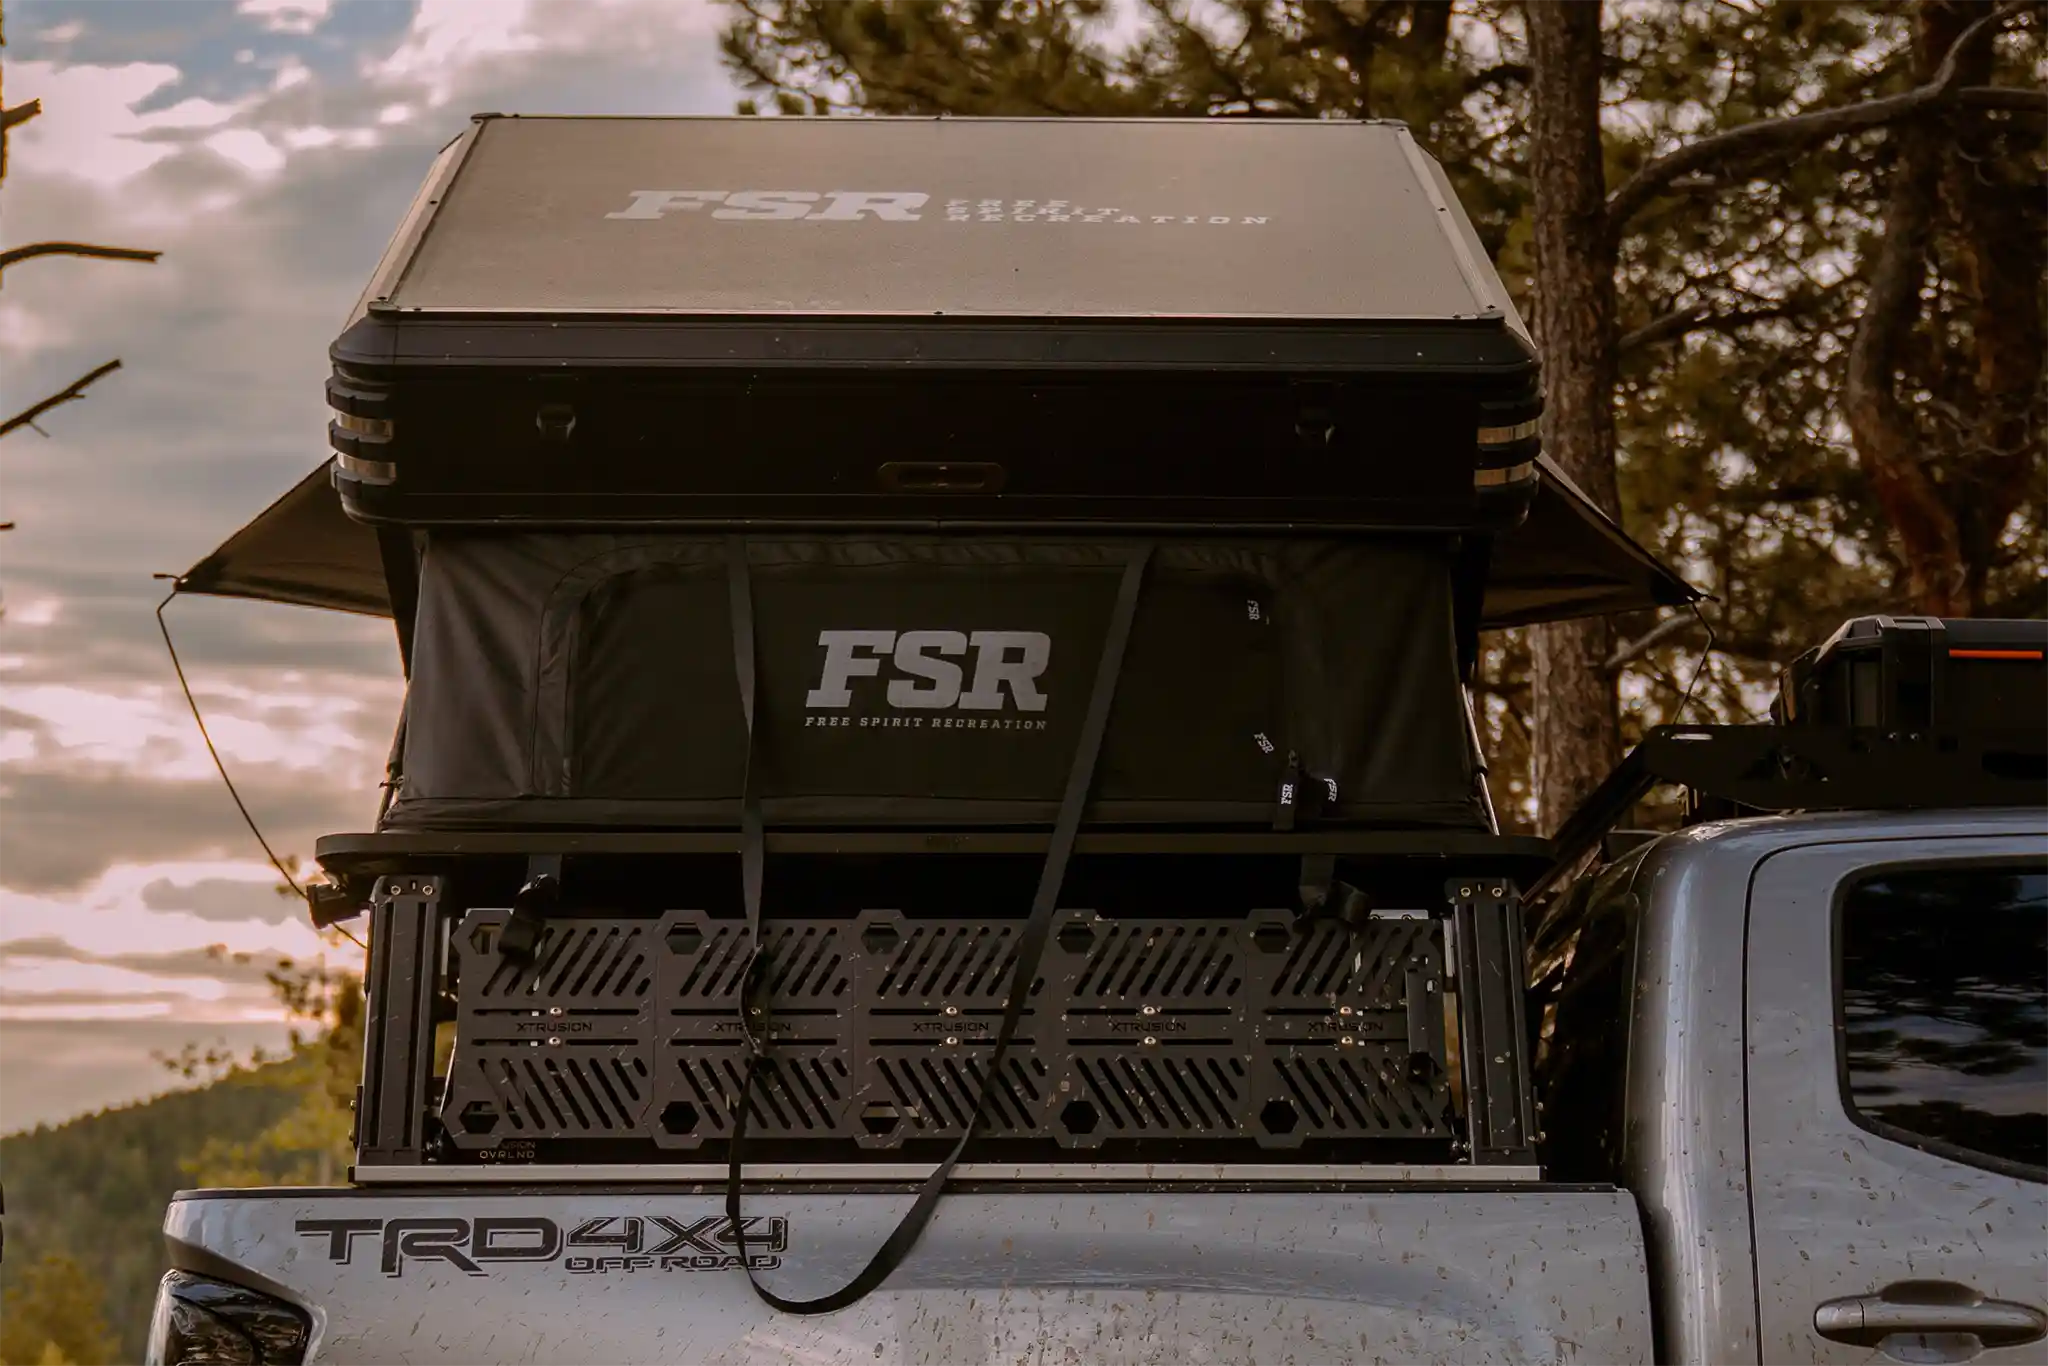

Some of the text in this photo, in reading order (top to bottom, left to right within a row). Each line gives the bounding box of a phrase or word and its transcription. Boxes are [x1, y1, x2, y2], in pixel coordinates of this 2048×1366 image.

[604, 190, 930, 222] FSR
[945, 200, 1070, 208] FREE
[945, 207, 1121, 216] SPIRIT
[944, 214, 1271, 225] RECREATION
[805, 630, 1051, 711] FSR
[804, 717, 1048, 731] FREE SPIRIT RECREATION
[1280, 783, 1294, 805] FSR
[516, 1022, 593, 1033] XTRUSION
[715, 1021, 791, 1033] XTRSION
[913, 1022, 989, 1033] XTRUSION
[1111, 1021, 1187, 1033] XTRUSION
[479, 1150, 536, 1159] OVRLND
[295, 1215, 788, 1278] TRD 4X4
[565, 1255, 782, 1273] OFF ROAD
